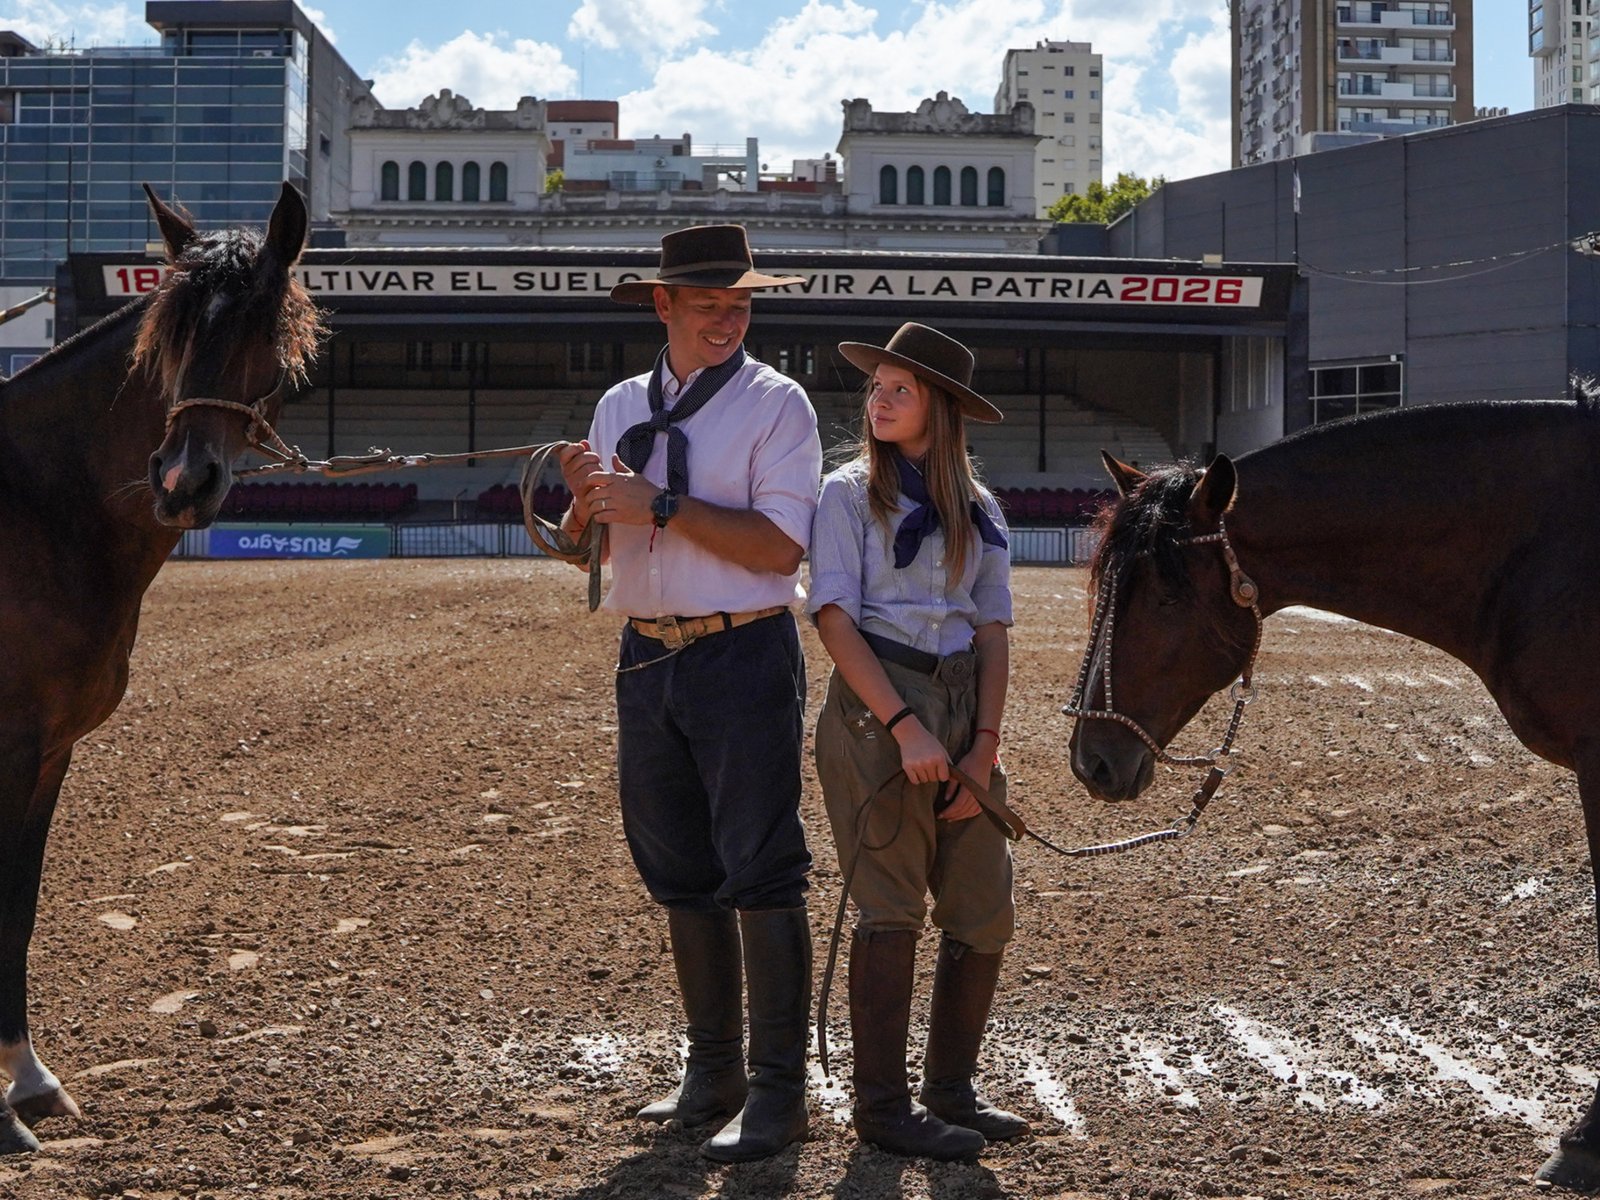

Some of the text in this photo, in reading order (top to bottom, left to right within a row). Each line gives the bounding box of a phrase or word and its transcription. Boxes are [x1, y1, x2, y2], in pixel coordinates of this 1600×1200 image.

[116, 268, 160, 293] 18
[303, 271, 435, 291] LTIVAR
[451, 271, 497, 291] EL
[752, 274, 854, 294] RVIR
[868, 275, 894, 295] A
[908, 276, 958, 296] LA
[970, 277, 1114, 298] PATRIA
[1120, 277, 1243, 304] 2026
[238, 533, 332, 553] RUSAgro
